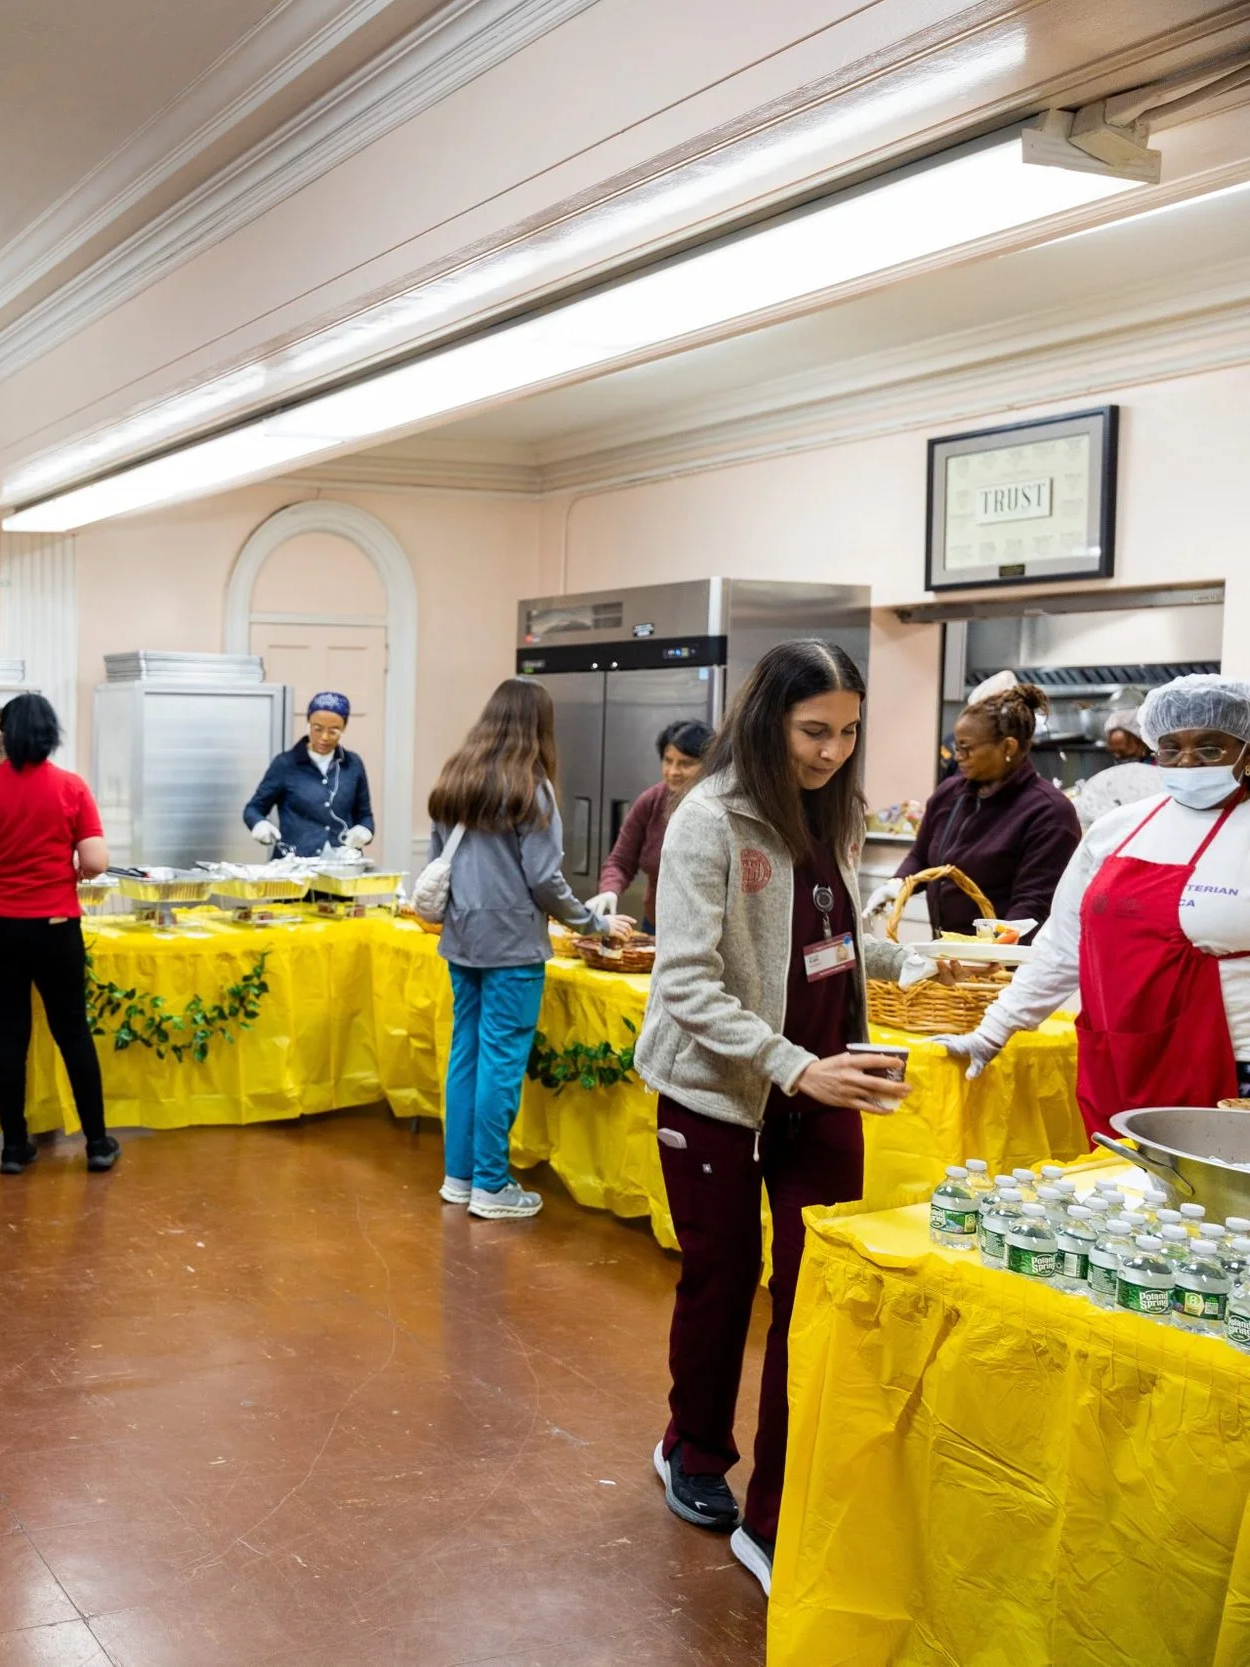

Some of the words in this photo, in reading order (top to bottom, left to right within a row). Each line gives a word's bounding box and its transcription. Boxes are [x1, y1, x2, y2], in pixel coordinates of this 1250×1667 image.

[980, 482, 1046, 515] TRUST
[1186, 884, 1239, 896] TERIAN
[1178, 899, 1196, 907] CA
[1139, 1291, 1168, 1301] Poland
[1140, 1299, 1168, 1309] Spring
